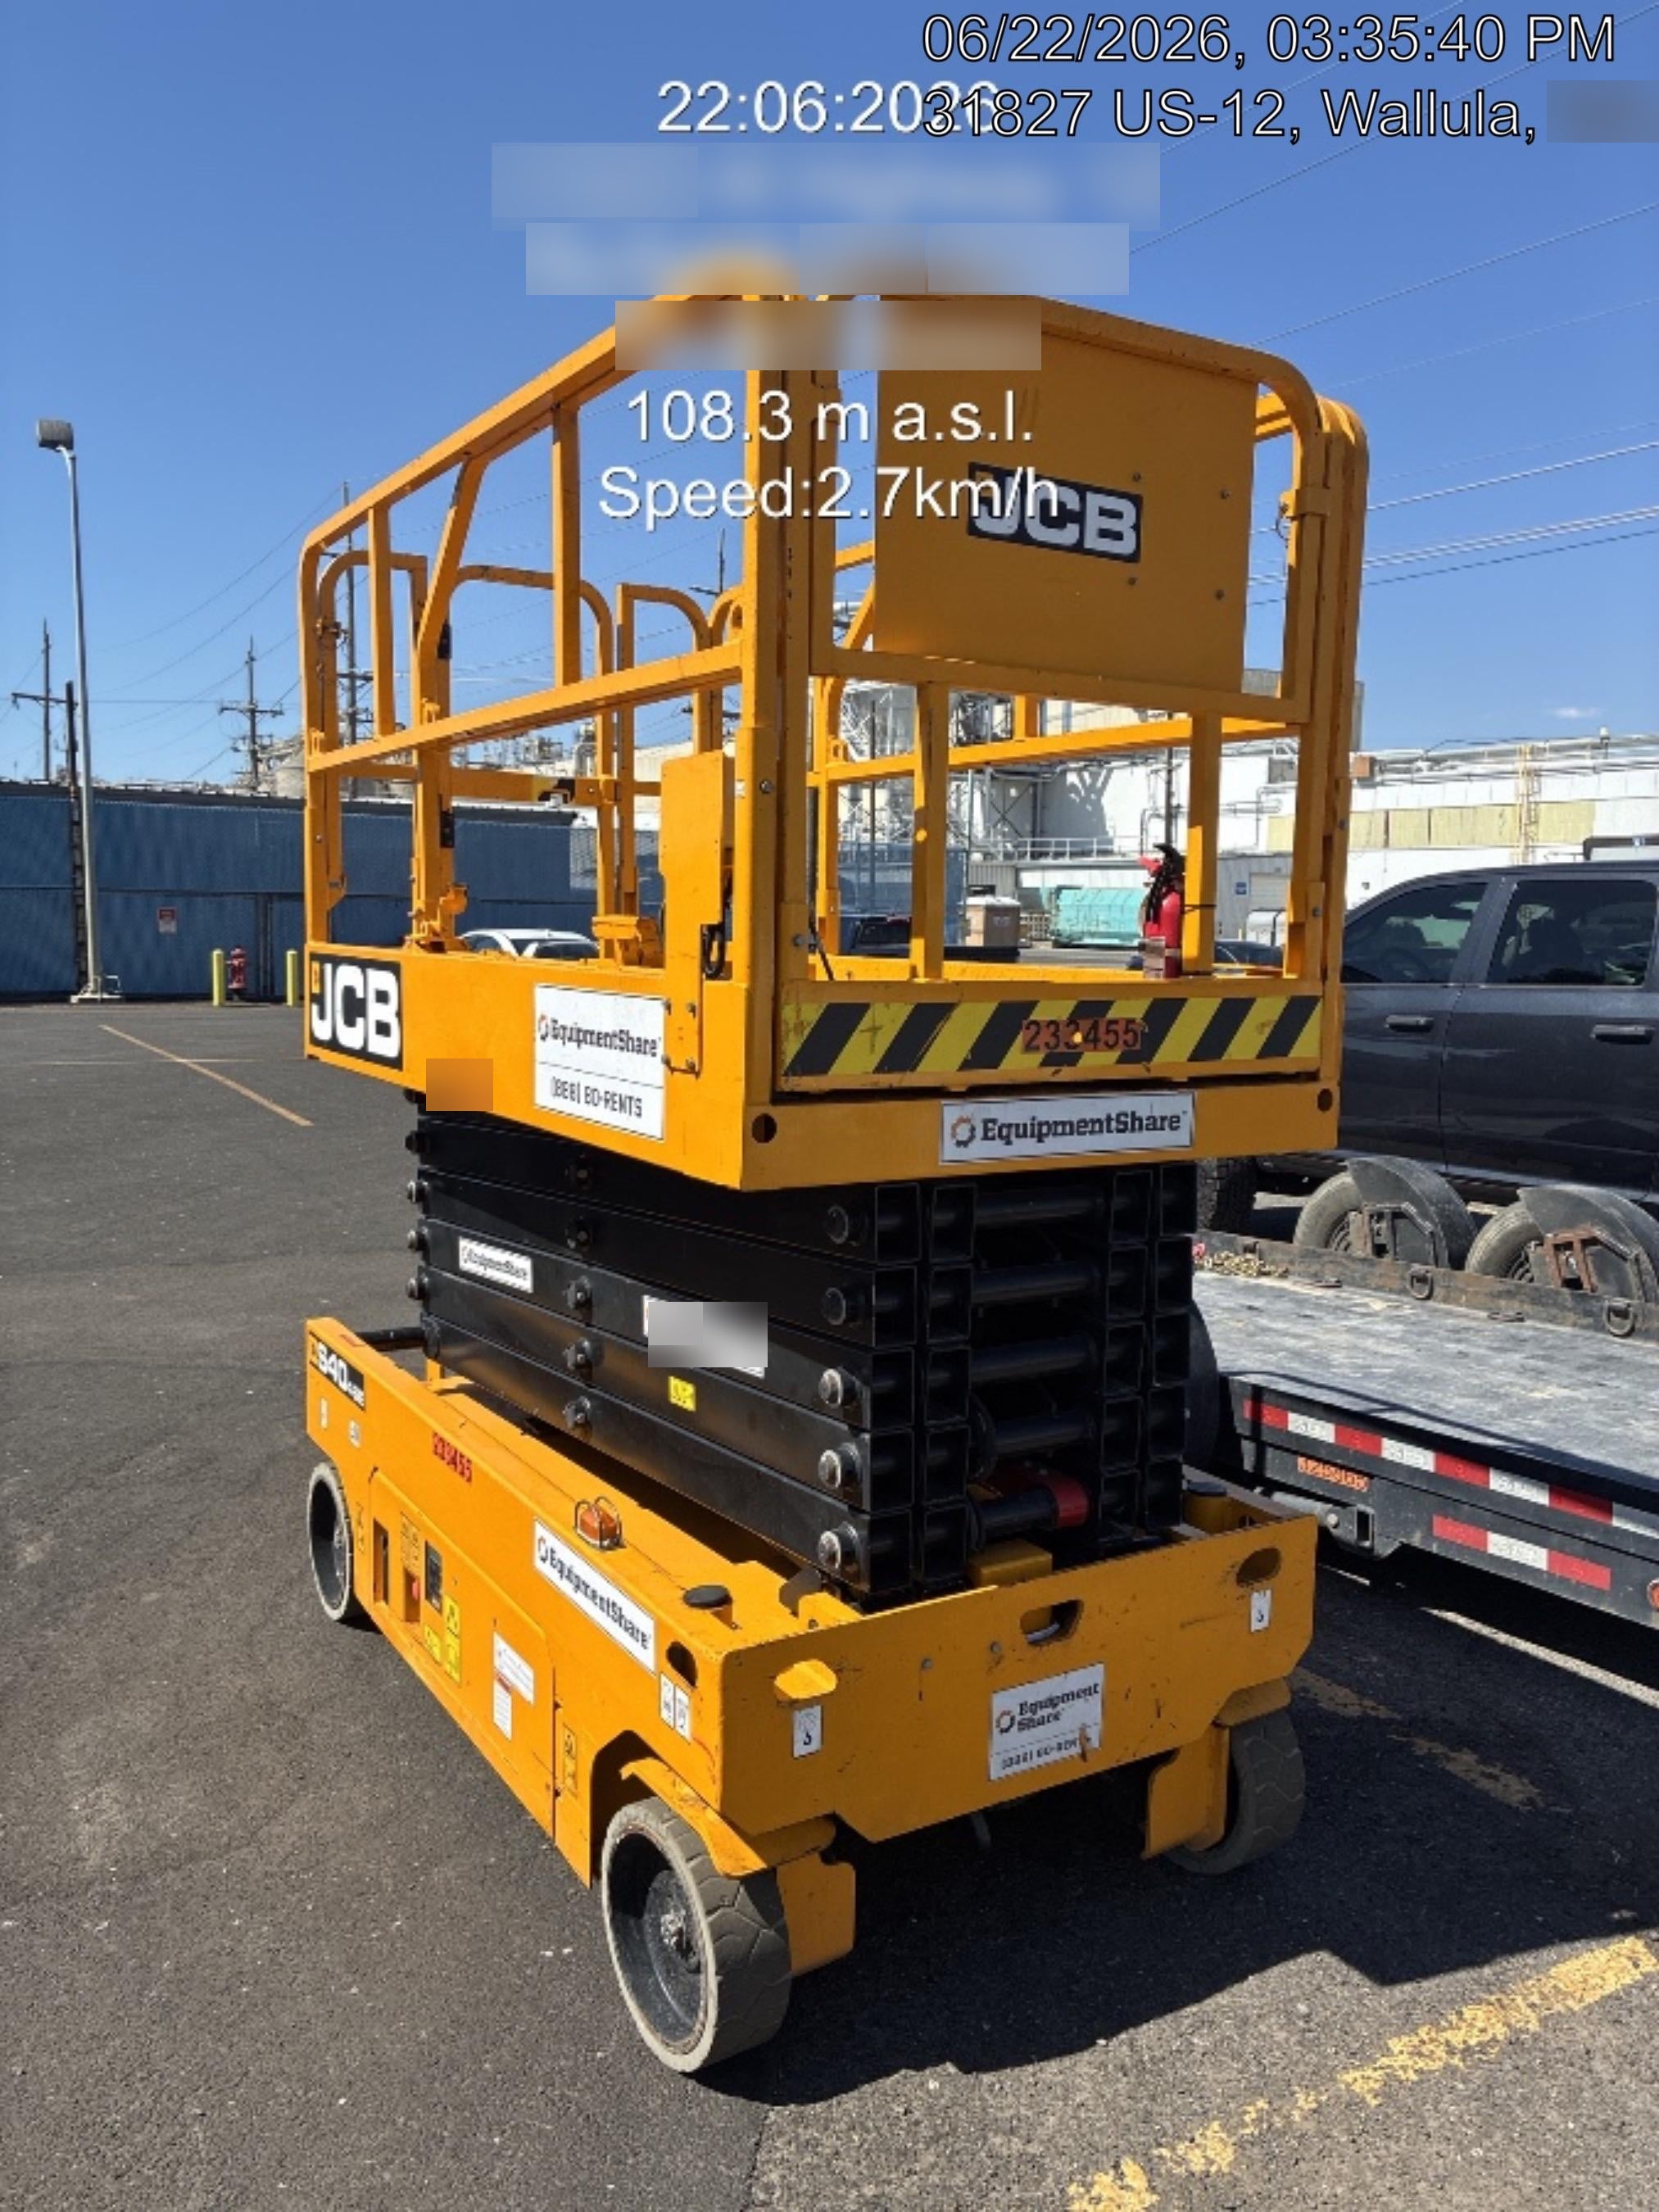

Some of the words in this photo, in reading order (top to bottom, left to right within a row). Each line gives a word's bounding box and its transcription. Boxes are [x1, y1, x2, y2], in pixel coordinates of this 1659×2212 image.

[974, 474, 1138, 556] JCB
[311, 962, 400, 1058] JCB
[551, 1017, 658, 1058] EquipmentShare
[1024, 1019, 1140, 1052] 233455
[981, 1111, 1181, 1145] EquipmentShare
[549, 1545, 650, 1652] EquipmentShare
[1018, 1682, 1099, 1716] Equipment
[1017, 1711, 1062, 1733] Share
